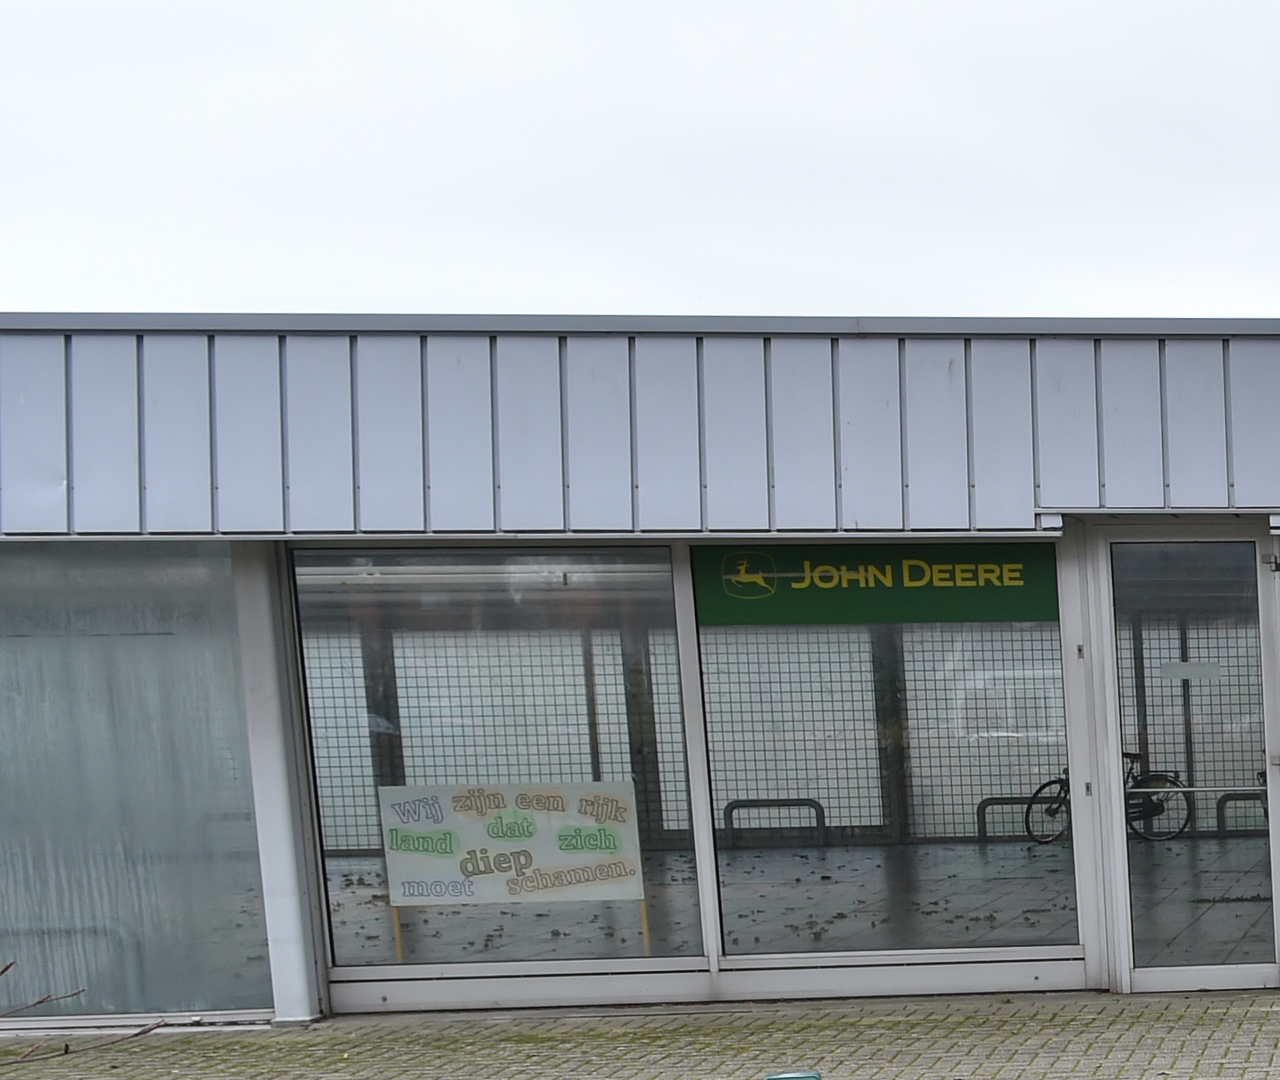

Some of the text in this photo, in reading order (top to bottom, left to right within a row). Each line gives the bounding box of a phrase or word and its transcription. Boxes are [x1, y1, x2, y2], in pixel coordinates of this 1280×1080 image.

[791, 559, 1025, 589] JOHN DEERE
[391, 788, 628, 824] Wij zijn een rijk
[389, 817, 618, 854] land dat zich
[401, 860, 637, 898] moet schamen.
[459, 847, 534, 878] diep
